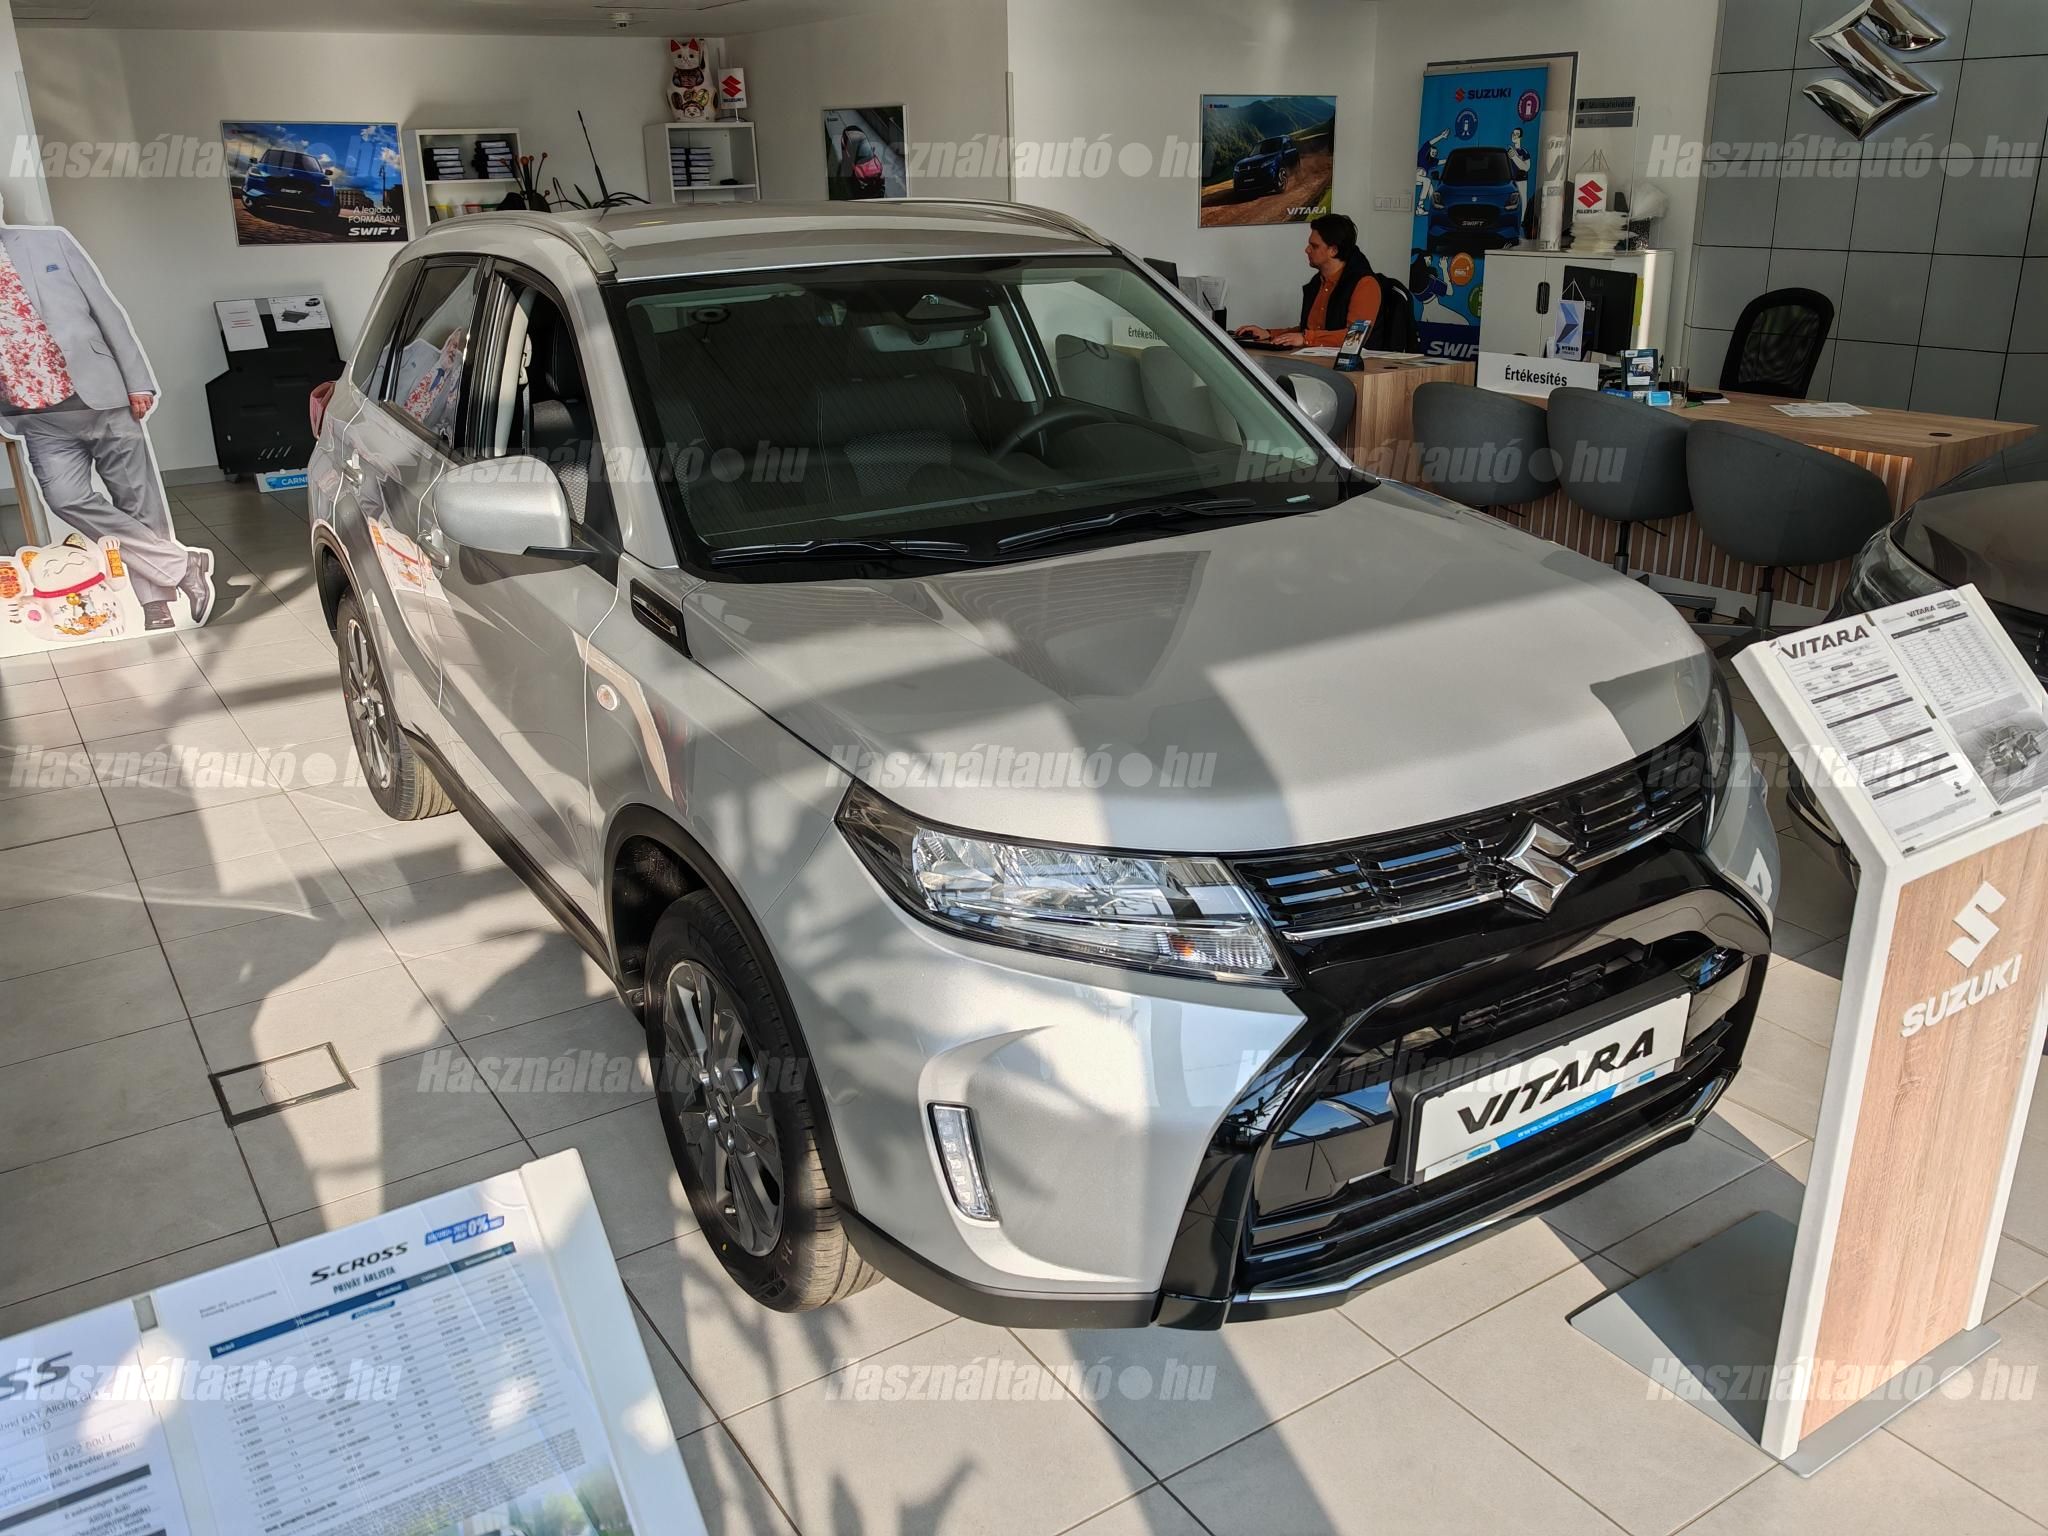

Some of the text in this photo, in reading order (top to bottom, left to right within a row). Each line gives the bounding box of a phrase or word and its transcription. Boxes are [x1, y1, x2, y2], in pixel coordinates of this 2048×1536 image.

[1468, 87, 1512, 100] SUZUKI
[348, 214, 400, 224] FORMÁBAN!
[1286, 205, 1327, 215] VITARA
[348, 226, 401, 236] SWIFT
[1427, 339, 1480, 358] SWIF
[1504, 363, 1568, 387] Értékesítés
[1779, 625, 1870, 660] VITARA
[1901, 953, 2023, 1038] SUZUKI
[1457, 1027, 1655, 1134] VITARA
